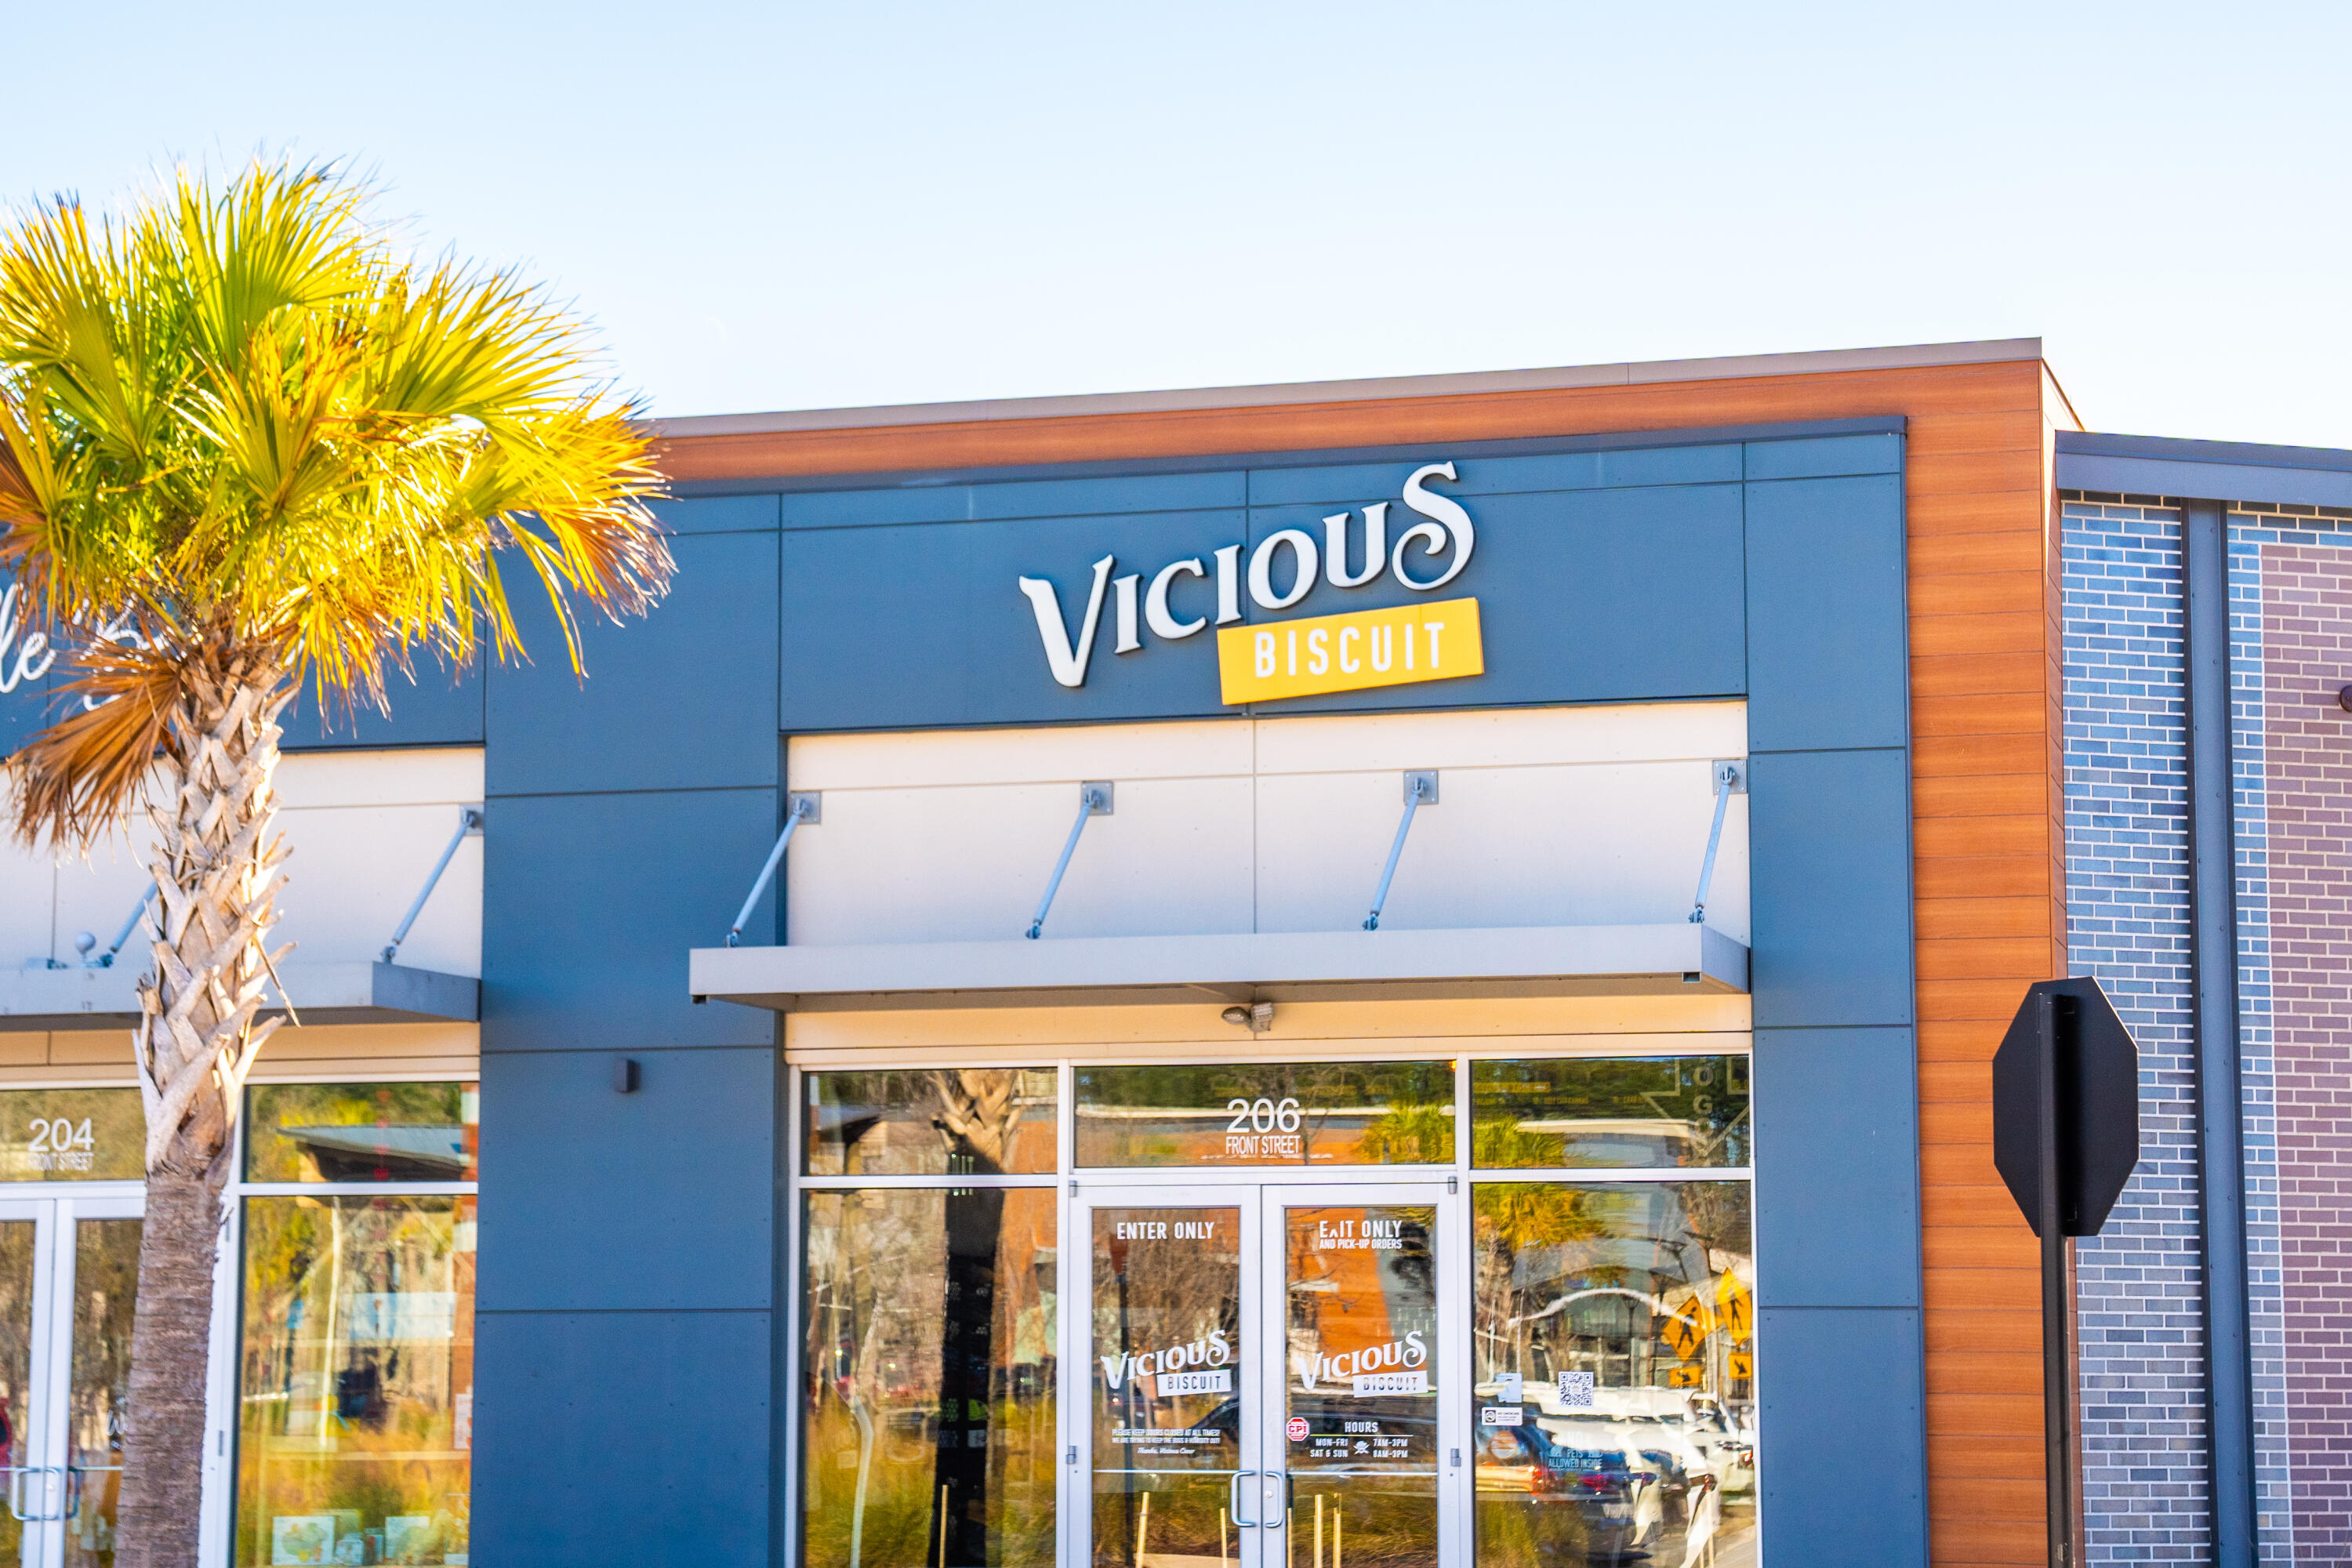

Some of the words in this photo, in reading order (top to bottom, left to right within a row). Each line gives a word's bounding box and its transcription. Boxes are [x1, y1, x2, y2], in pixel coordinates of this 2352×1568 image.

[1019, 461, 1475, 688] VICIOUS
[1255, 622, 1444, 678] BISCUIT
[1226, 1098, 1301, 1134] 206
[28, 1118, 94, 1151] 204
[1225, 1135, 1260, 1155] FRONT
[1261, 1134, 1301, 1155] STREET
[58, 1152, 94, 1171] STREET
[1116, 1221, 1167, 1240] ENTER
[1174, 1221, 1215, 1240] ONLY
[1361, 1219, 1403, 1238] ONLY
[1319, 1239, 1336, 1249] AND
[1338, 1239, 1370, 1249] PICK-UP
[1371, 1238, 1403, 1249] ORDERS
[1101, 1330, 1230, 1389] VICIOUS
[1297, 1330, 1427, 1390] VICIOUS
[1167, 1375, 1221, 1390] BISCUIT
[1363, 1376, 1418, 1391] BISCUIT
[1345, 1421, 1379, 1433] HOURS
[1548, 1458, 1579, 1468] ALLOWED
